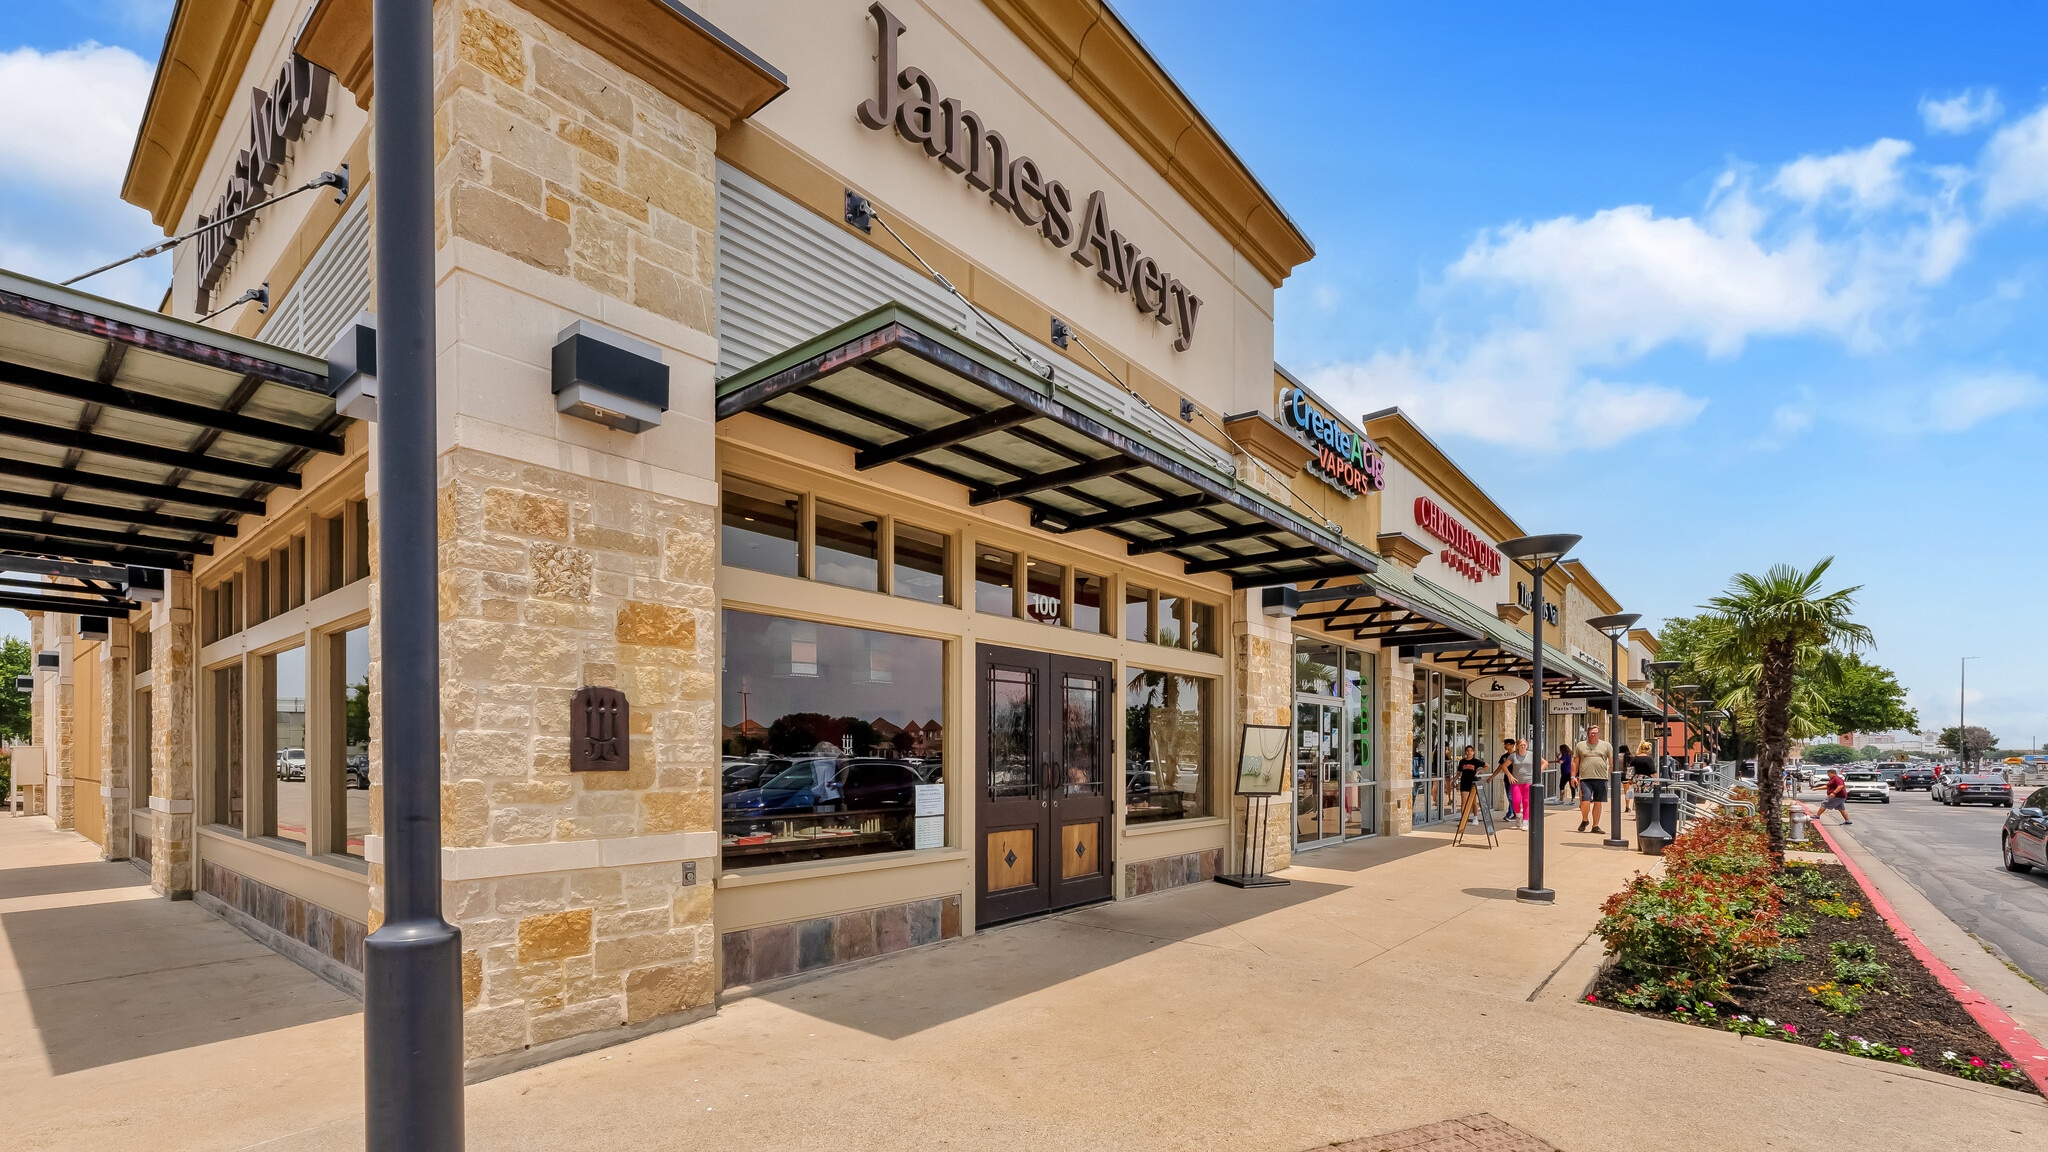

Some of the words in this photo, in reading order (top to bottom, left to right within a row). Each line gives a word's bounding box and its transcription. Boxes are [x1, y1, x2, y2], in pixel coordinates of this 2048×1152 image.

[857, 1, 1073, 249] James
[1071, 190, 1203, 352] Avery
[194, 148, 266, 316] ames
[1315, 443, 1368, 496] VAPORS
[1414, 496, 1478, 564] CHRISTIAN
[1478, 541, 1502, 576] GIFTS
[1032, 593, 1058, 617] 100
[1517, 581, 1534, 611] The
